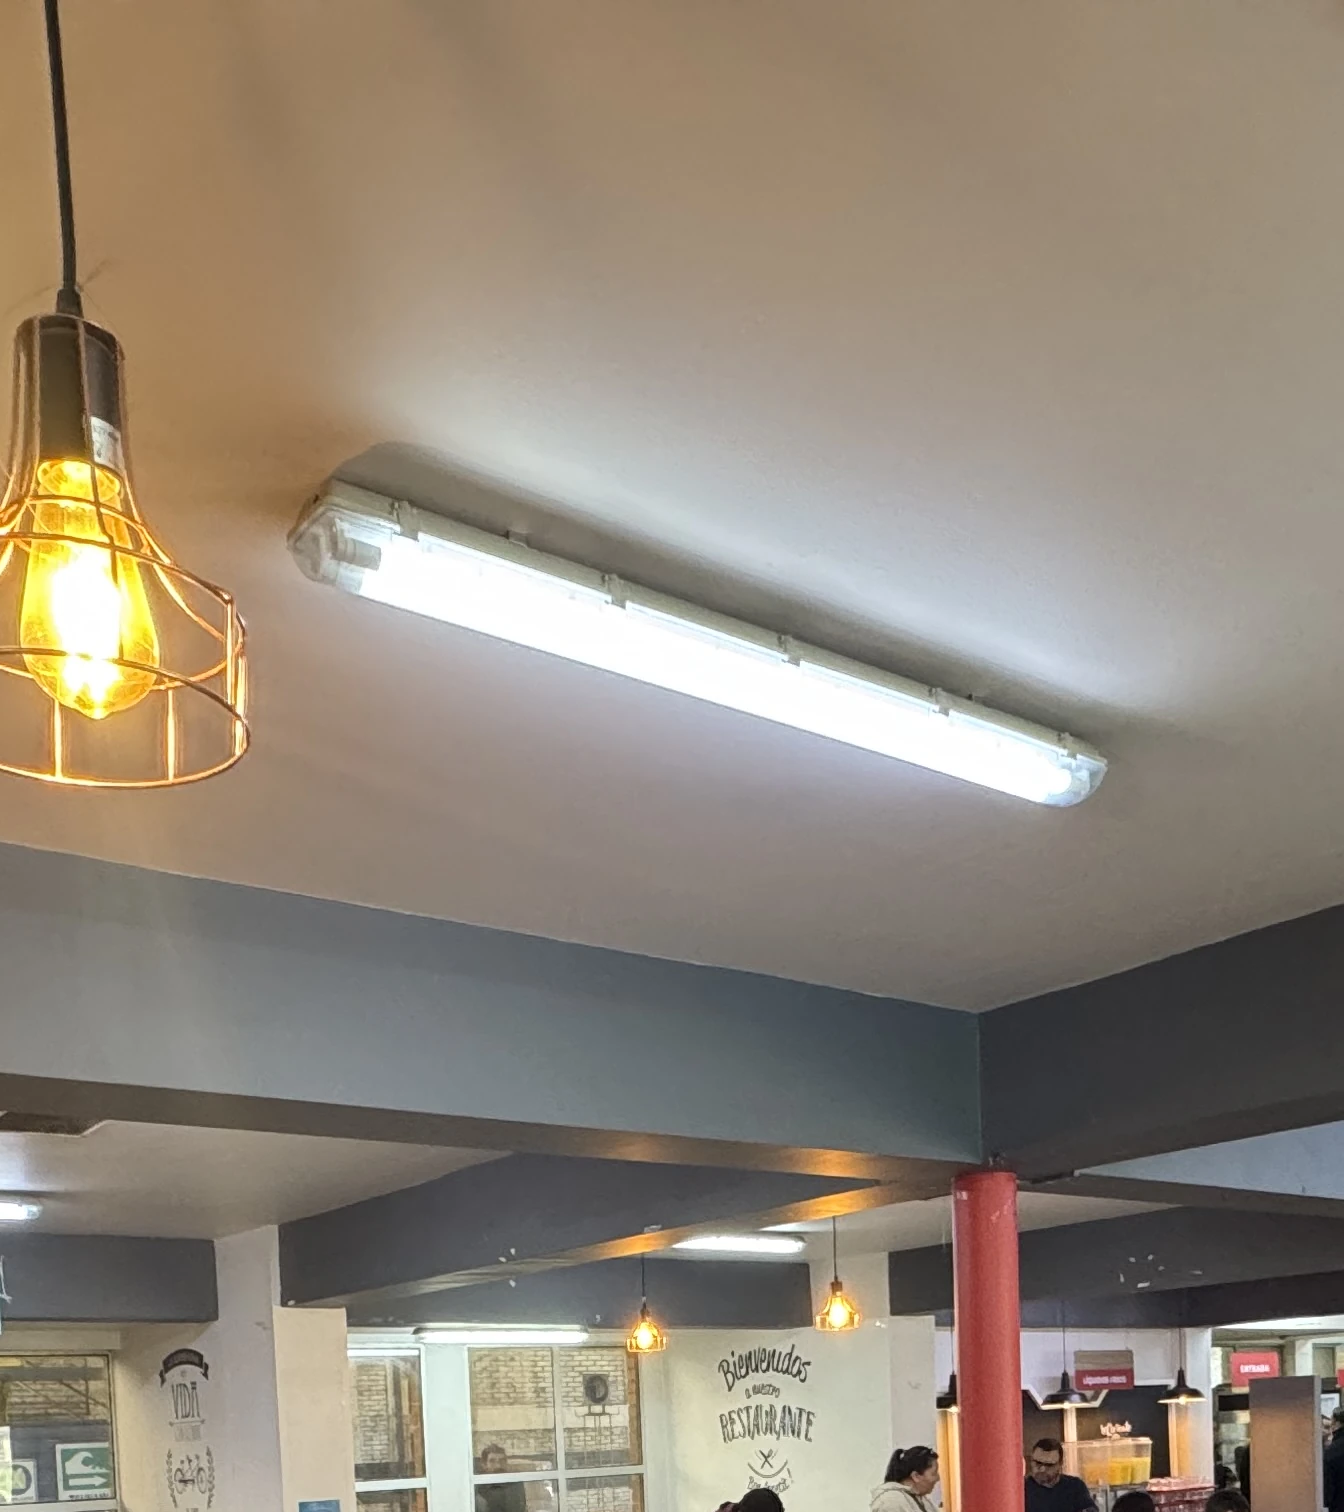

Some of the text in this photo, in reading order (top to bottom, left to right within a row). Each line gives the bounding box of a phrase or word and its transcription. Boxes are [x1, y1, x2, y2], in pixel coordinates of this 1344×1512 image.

[718, 1343, 812, 1392] Bienvenidos
[1239, 1363, 1271, 1374] ENTRADA
[752, 1382, 781, 1399] nuestro
[719, 1404, 816, 1444] RESTAURANTE
